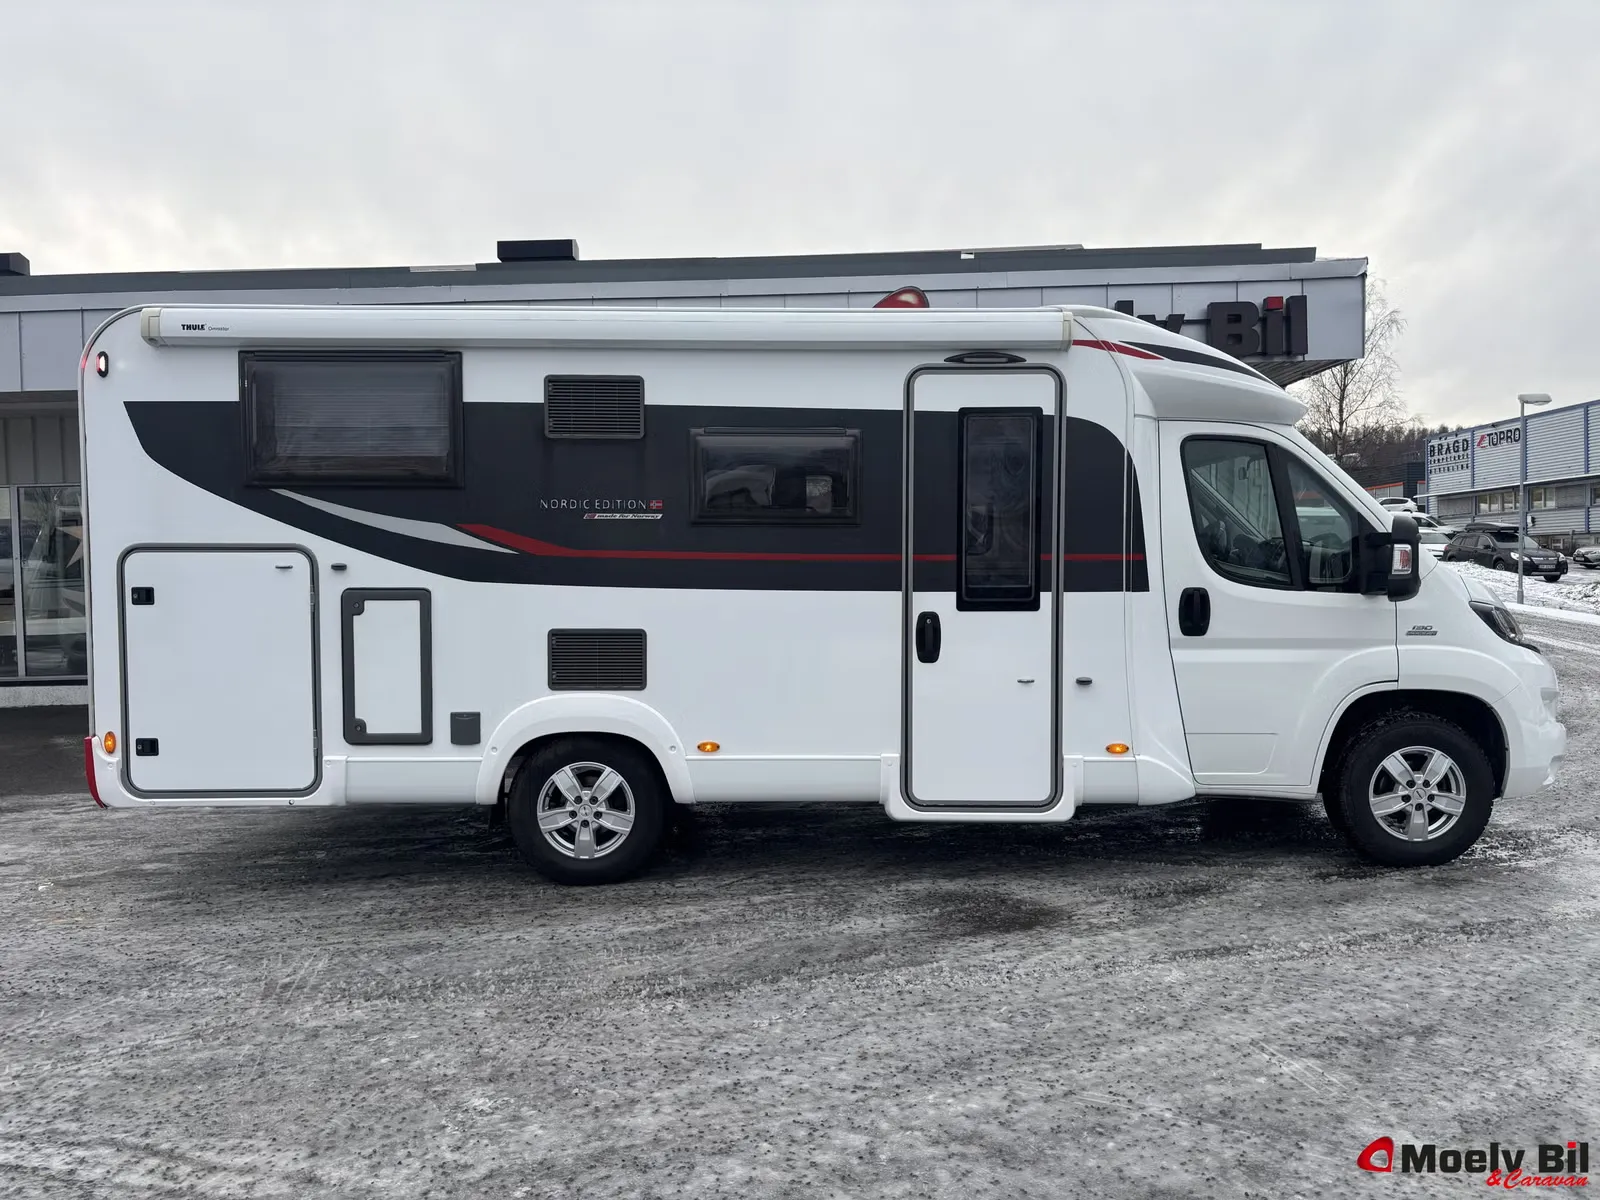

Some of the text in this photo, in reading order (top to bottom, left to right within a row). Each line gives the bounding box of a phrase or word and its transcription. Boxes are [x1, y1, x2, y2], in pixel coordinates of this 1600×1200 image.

[1207, 295, 1309, 355] Bil
[1487, 428, 1521, 447] TOPRO
[540, 499, 646, 509] NORDIC EDITION
